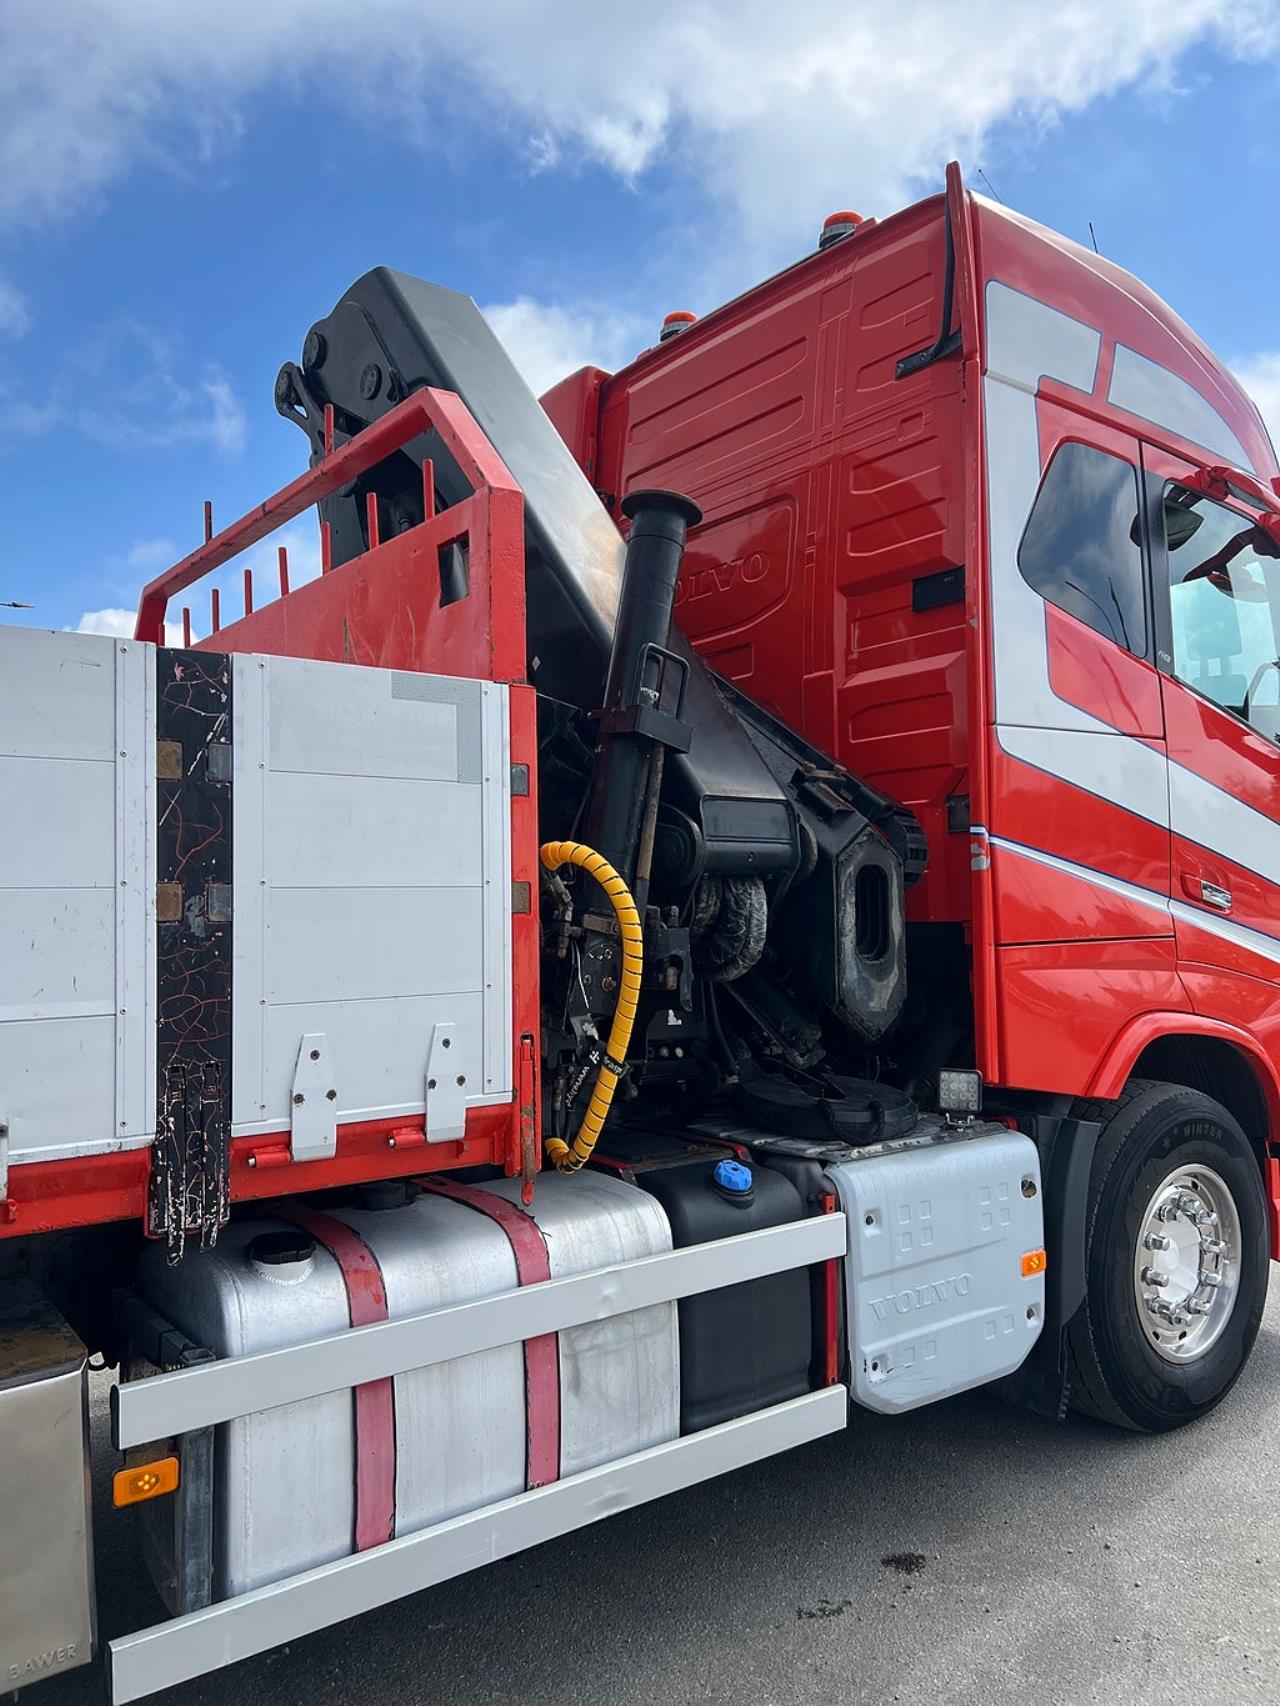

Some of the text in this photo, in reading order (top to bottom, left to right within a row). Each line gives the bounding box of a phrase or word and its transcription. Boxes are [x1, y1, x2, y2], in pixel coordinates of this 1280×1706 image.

[674, 551, 769, 607] OLVO
[1183, 1122, 1223, 1141] WINTER
[868, 1272, 974, 1321] VOLVO
[9, 1643, 77, 1679] BAWER
